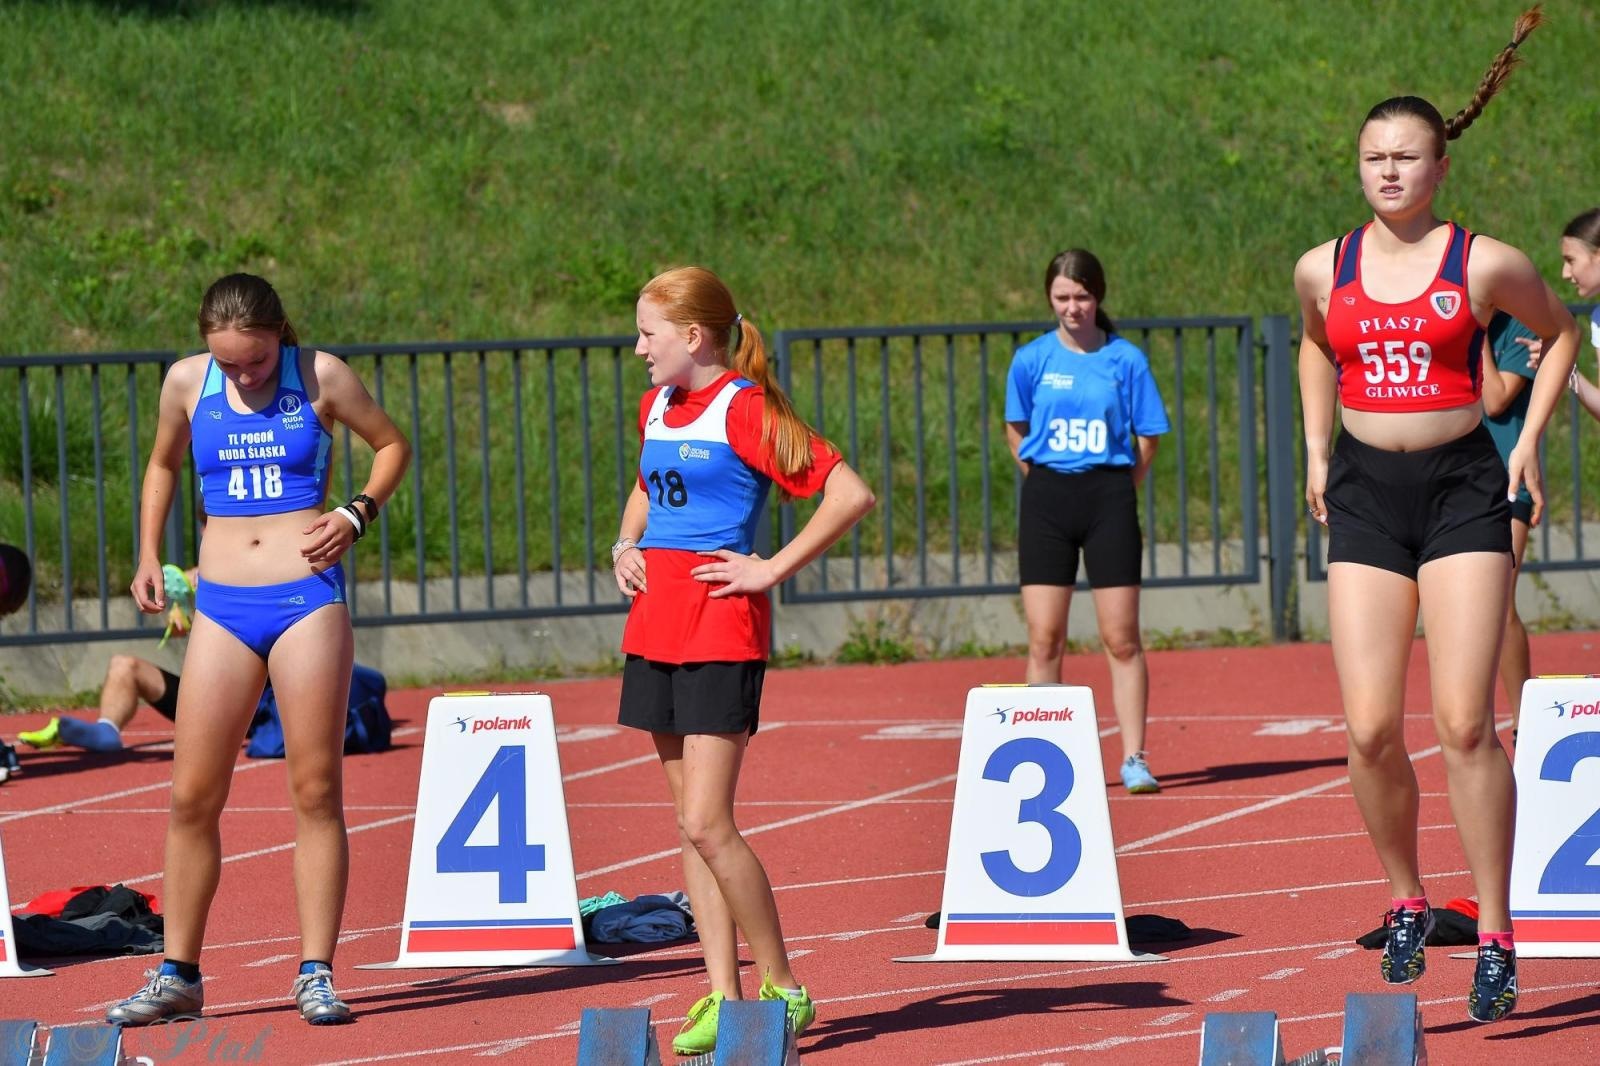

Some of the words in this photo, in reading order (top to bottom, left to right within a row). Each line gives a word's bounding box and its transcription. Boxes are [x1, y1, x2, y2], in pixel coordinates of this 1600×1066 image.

[1358, 316, 1427, 334] PIAST
[1357, 340, 1432, 384] 559
[1365, 384, 1440, 397] GLIWICE
[282, 416, 304, 425] RUDA
[228, 433, 239, 446] TL
[241, 430, 274, 444] POGOŃ
[1047, 418, 1107, 454] 350
[219, 449, 246, 461] RUDA
[248, 446, 286, 459] ŚLĄSKA
[228, 464, 283, 499] 418
[648, 469, 688, 508] 18
[1011, 706, 1075, 726] polanik
[1570, 700, 1600, 719] pol
[471, 715, 533, 734] polanik
[981, 737, 1082, 897] 3
[1538, 731, 1600, 895] 2
[436, 745, 546, 904] 4
